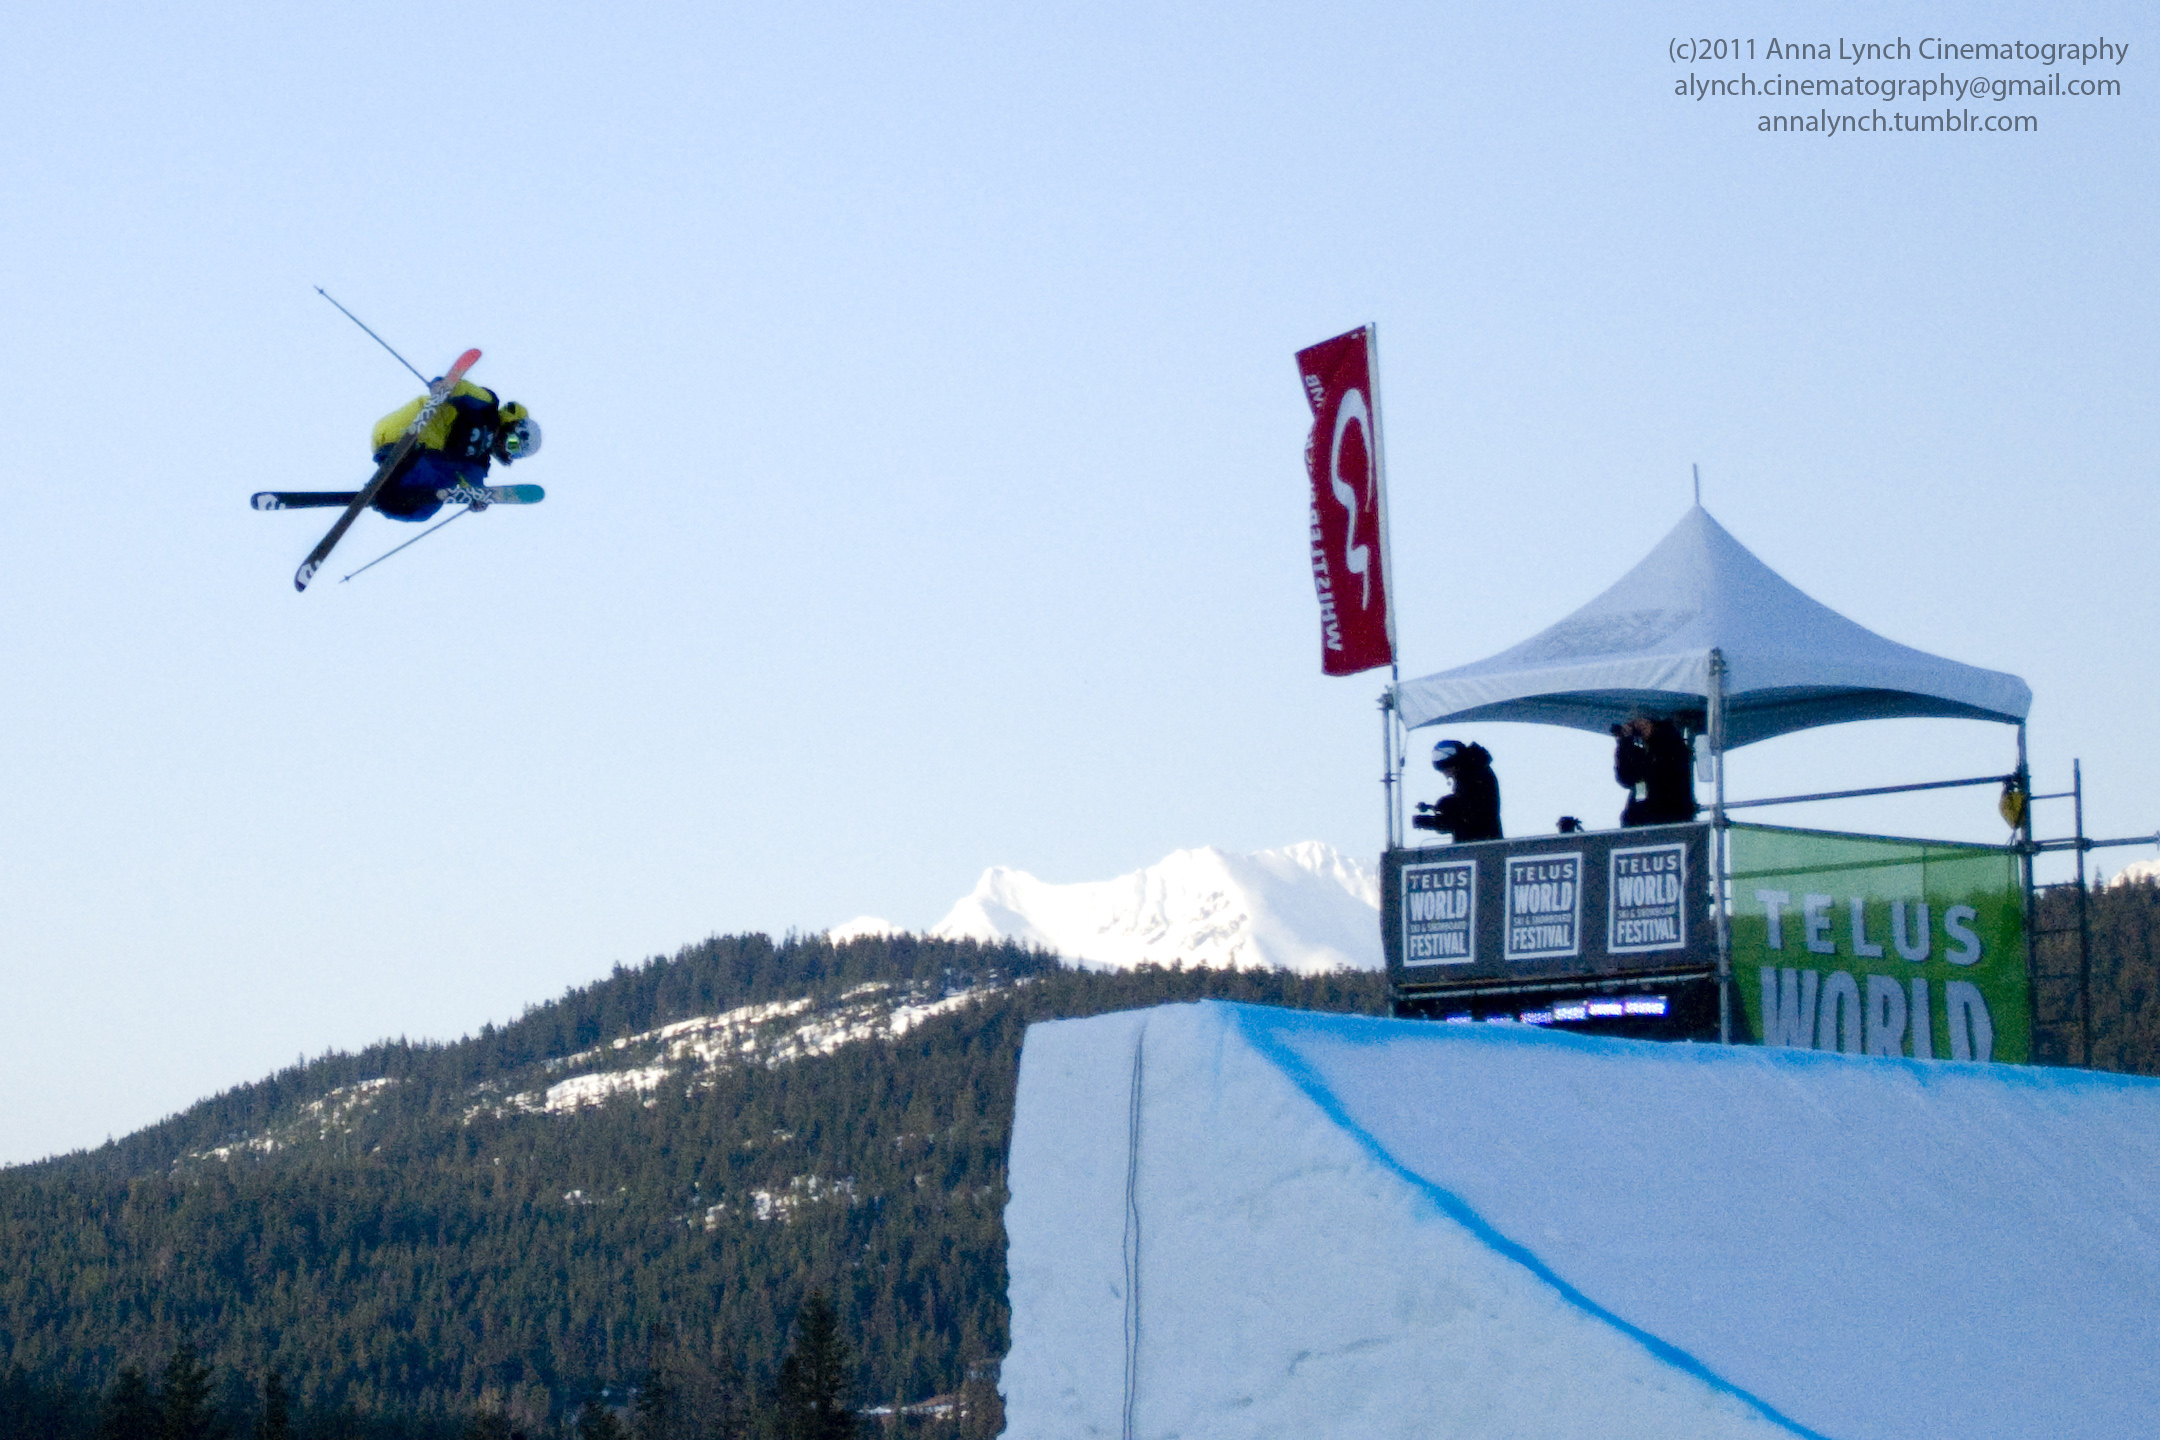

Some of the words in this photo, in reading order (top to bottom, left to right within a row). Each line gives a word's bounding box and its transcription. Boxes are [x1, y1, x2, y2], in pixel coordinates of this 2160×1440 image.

[1514, 863, 1573, 882] TELUS
[1618, 855, 1677, 874] TELUS
[1410, 871, 1467, 889] TELUS
[1618, 873, 1679, 907] WORLD
[1410, 889, 1468, 921] WORLD
[1514, 881, 1573, 914] WORLD
[1512, 924, 1571, 950] FESTIVAL
[1616, 917, 1677, 944] FESTIVAL
[1755, 889, 1982, 967] TELUS
[1410, 931, 1467, 957] FESTIVAL
